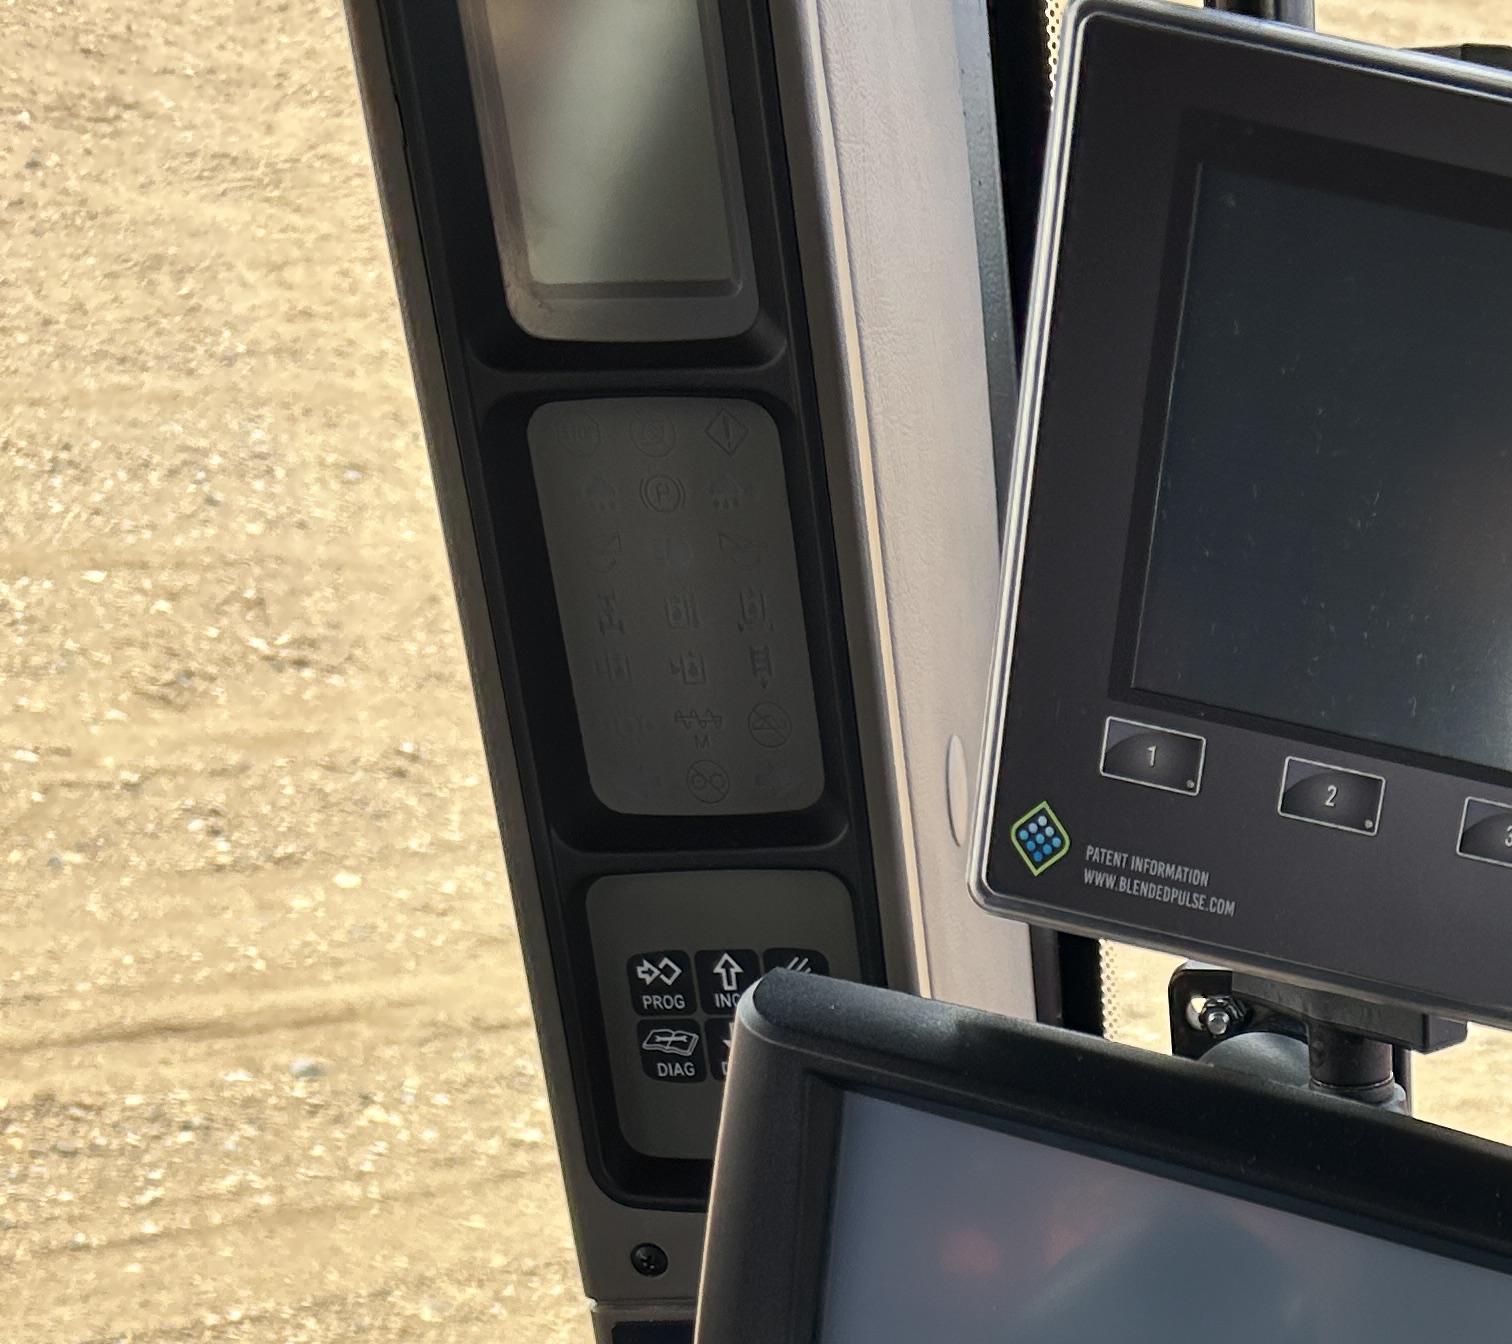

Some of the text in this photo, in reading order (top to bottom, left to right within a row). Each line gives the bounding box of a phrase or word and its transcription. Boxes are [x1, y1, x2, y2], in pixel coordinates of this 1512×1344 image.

[1147, 745, 1157, 767] 1
[1324, 785, 1339, 807] 2
[1085, 845, 1210, 888] PATENT INFORMATION
[1083, 868, 1236, 917] WWW.BLENDEDPULSE.COM
[642, 995, 686, 1010] PROG
[656, 1062, 696, 1077] DIAG
